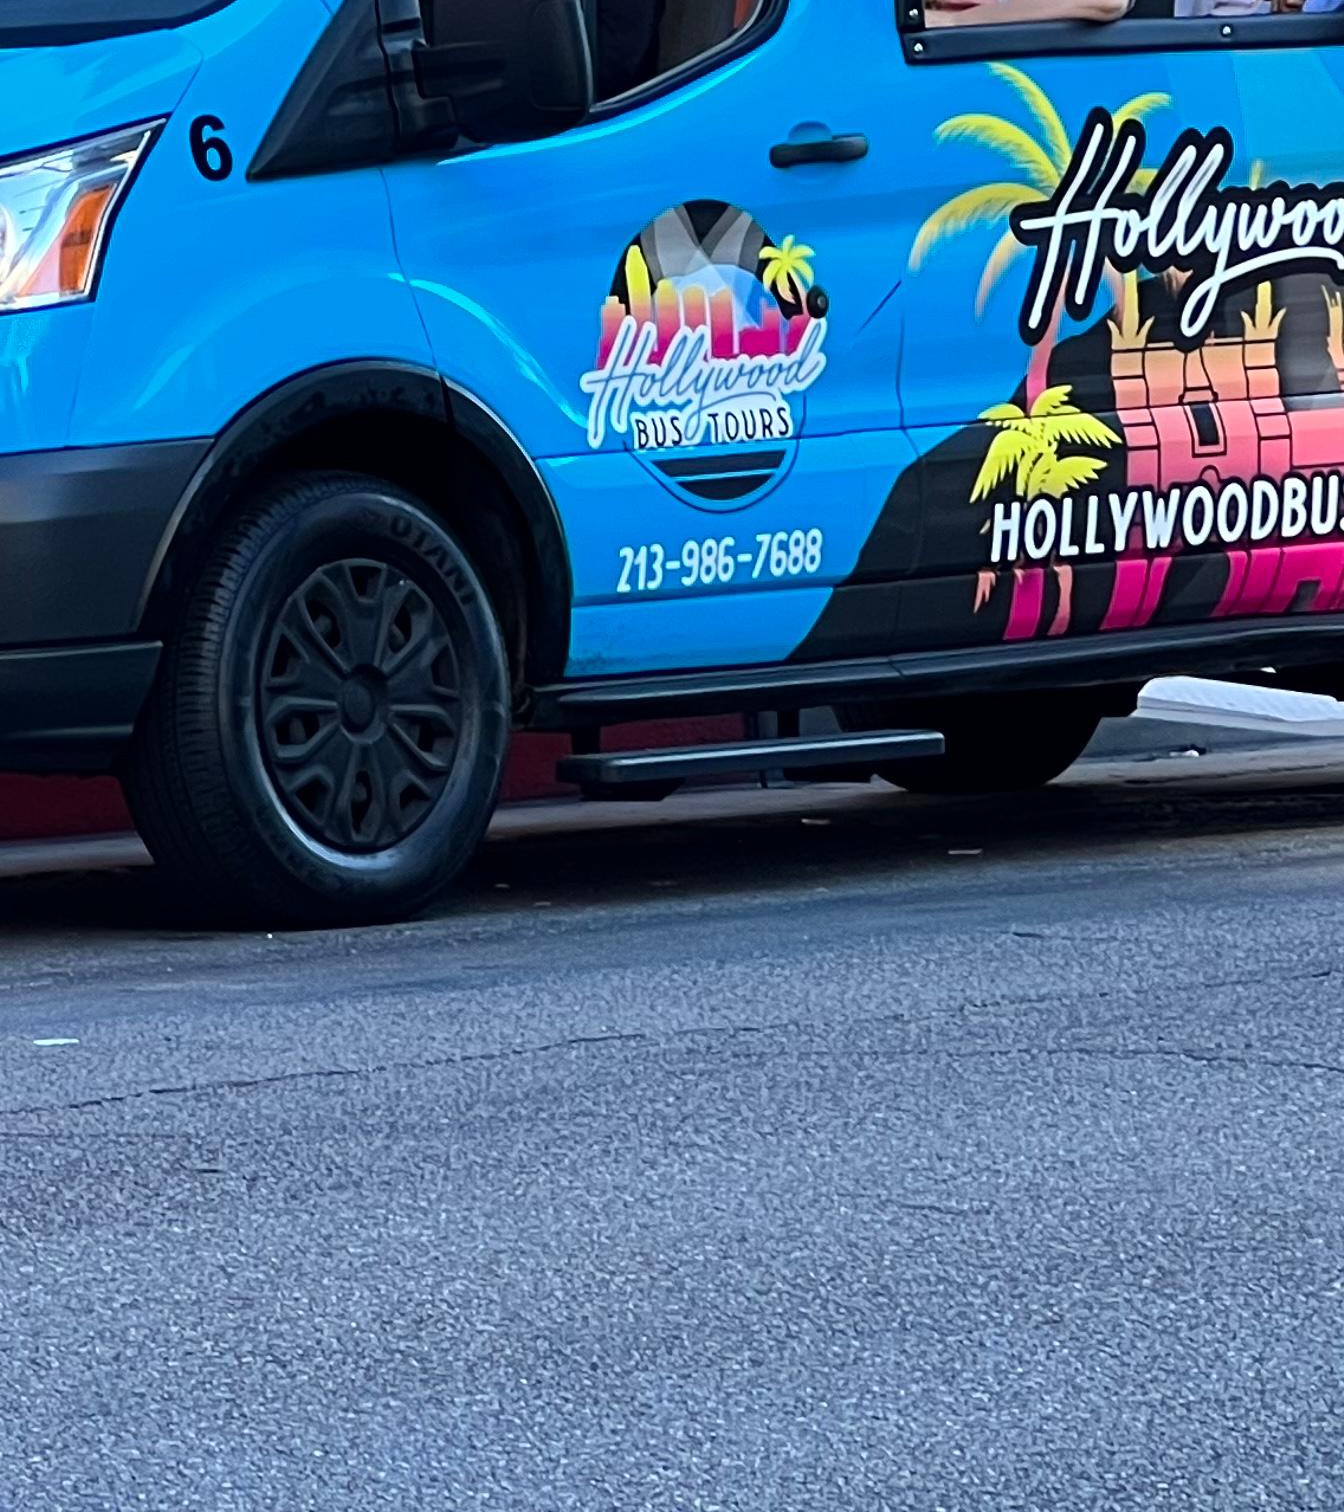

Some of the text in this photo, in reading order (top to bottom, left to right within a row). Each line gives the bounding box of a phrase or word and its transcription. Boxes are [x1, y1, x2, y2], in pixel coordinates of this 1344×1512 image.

[189, 113, 233, 182] 6
[583, 317, 826, 446] Hollywood
[634, 406, 790, 449] BUS TOURS
[616, 528, 823, 593] 213-986-7688
